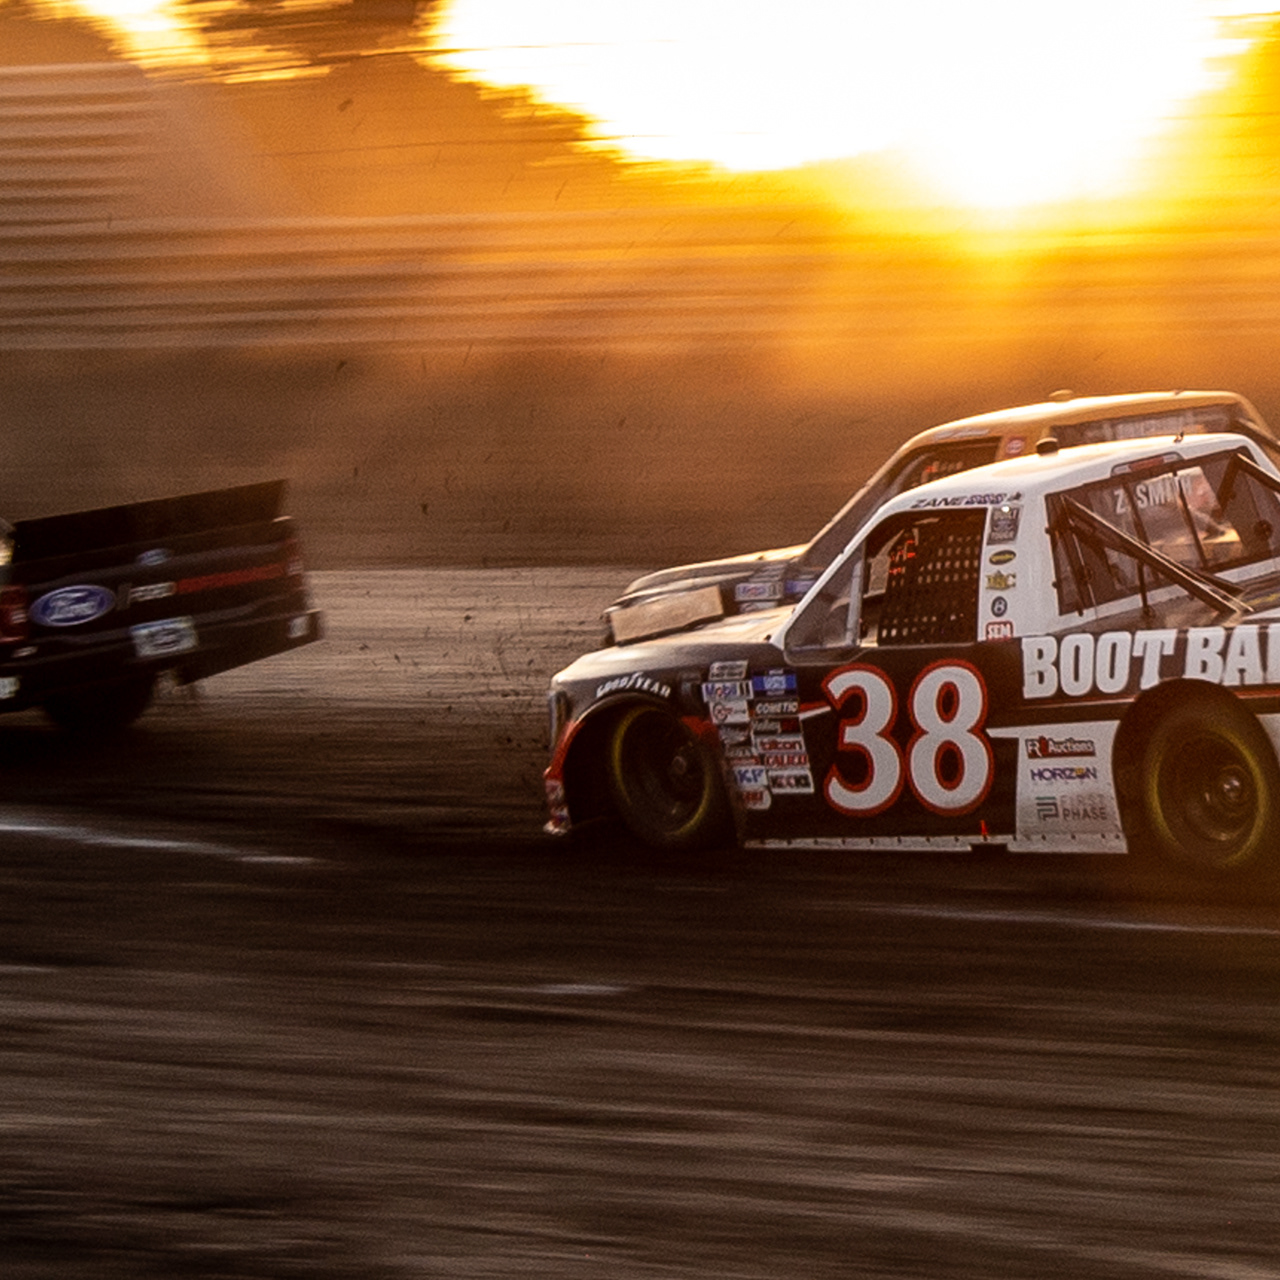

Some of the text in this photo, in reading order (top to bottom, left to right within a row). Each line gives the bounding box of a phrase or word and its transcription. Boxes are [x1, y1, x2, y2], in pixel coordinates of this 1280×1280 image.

[911, 495, 964, 509] ZANE
[1113, 487, 1128, 515] Z
[1021, 628, 1178, 700] BOOT
[823, 661, 992, 814] 38
[1030, 765, 1098, 781] HORIZON
[1062, 806, 1108, 821] PHASE
